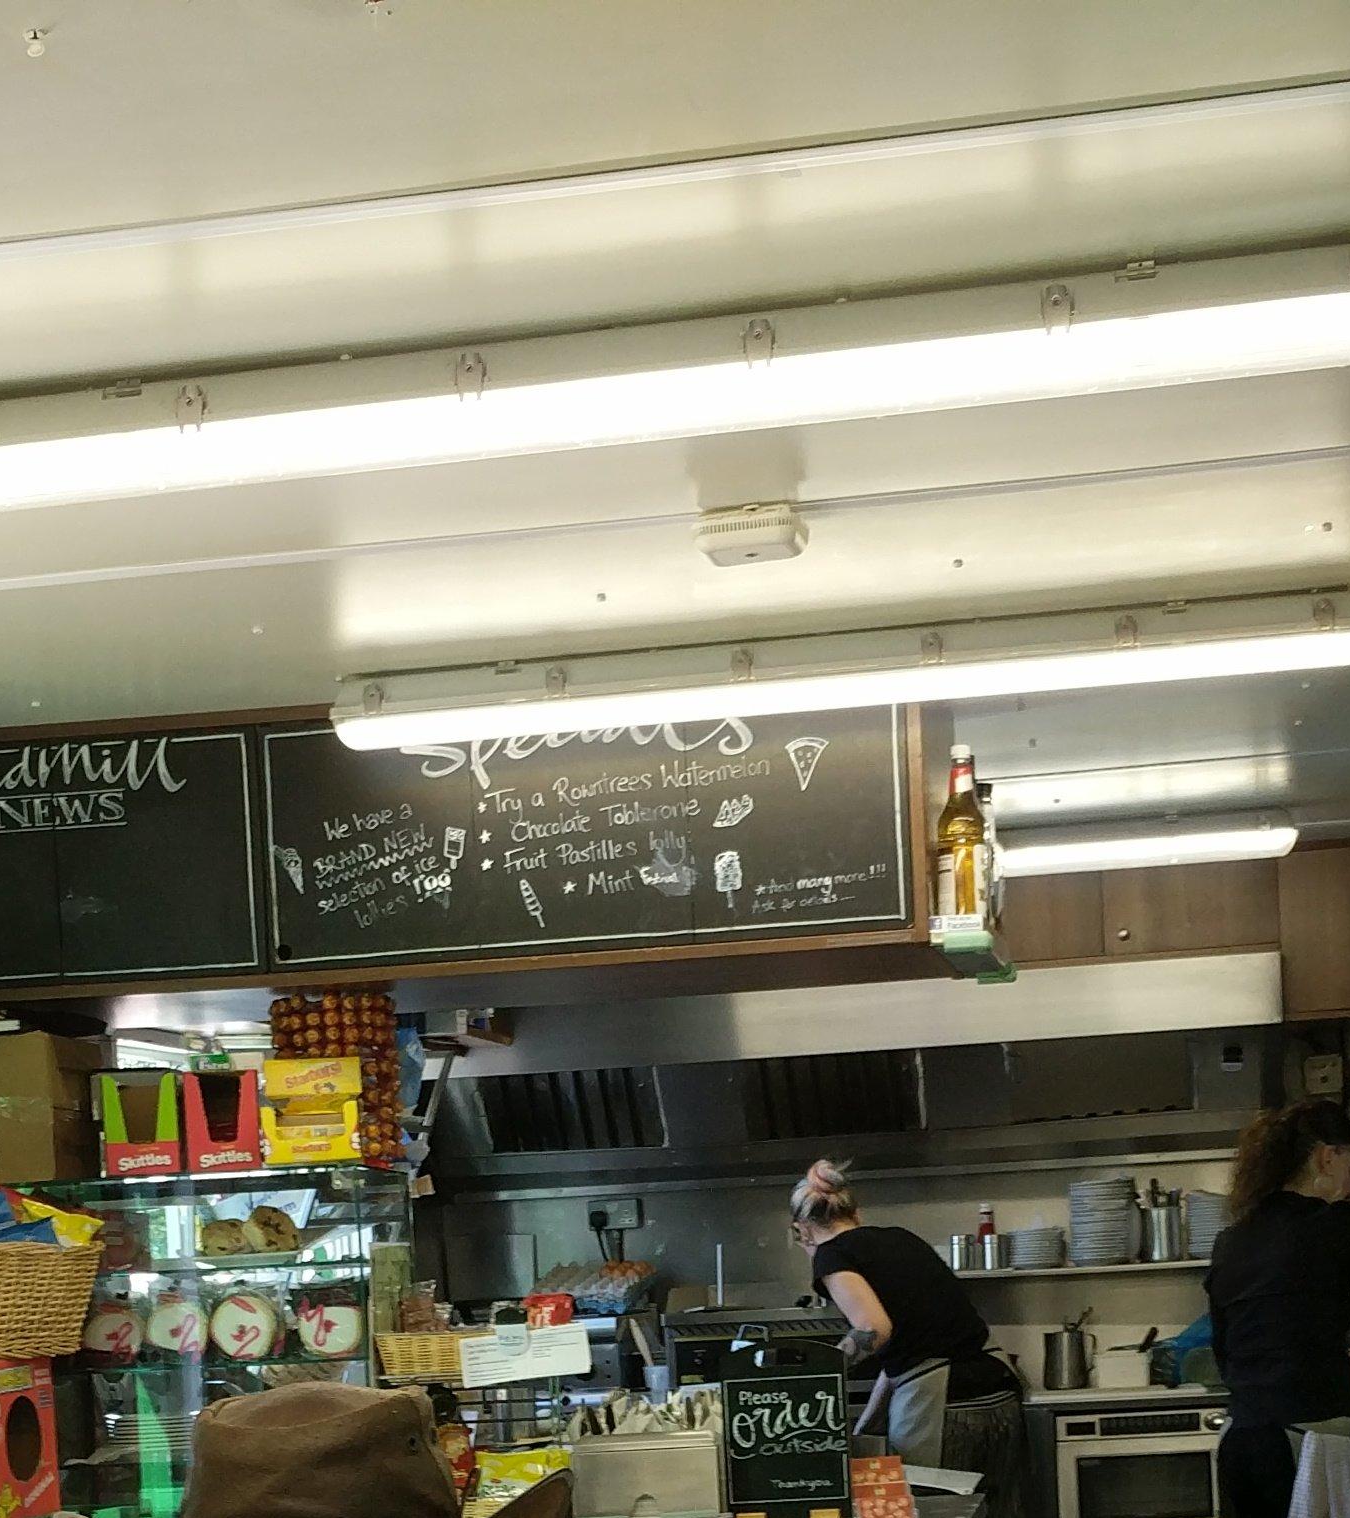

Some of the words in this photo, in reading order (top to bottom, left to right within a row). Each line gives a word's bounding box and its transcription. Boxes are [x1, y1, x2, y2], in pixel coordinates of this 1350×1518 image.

[484, 786, 524, 824] Try
[531, 791, 545, 808] a
[659, 756, 771, 790] Watermelon
[322, 816, 351, 842] We
[351, 808, 394, 833] have
[399, 802, 414, 820] a
[510, 812, 592, 844] Chocolate
[598, 797, 702, 828] Toblerone
[312, 842, 378, 880] BRAND
[382, 822, 427, 853] NEW
[502, 846, 549, 874] Fruit
[555, 839, 638, 866] Pastilles
[317, 877, 387, 915] selection
[391, 865, 413, 887] of
[413, 855, 440, 875] ice
[586, 869, 636, 896] Mint
[117, 1152, 173, 1172] Skittles
[199, 1151, 254, 1169] Skittles
[738, 1390, 790, 1406] Please
[732, 1390, 847, 1449] order
[758, 1435, 848, 1456] outside
